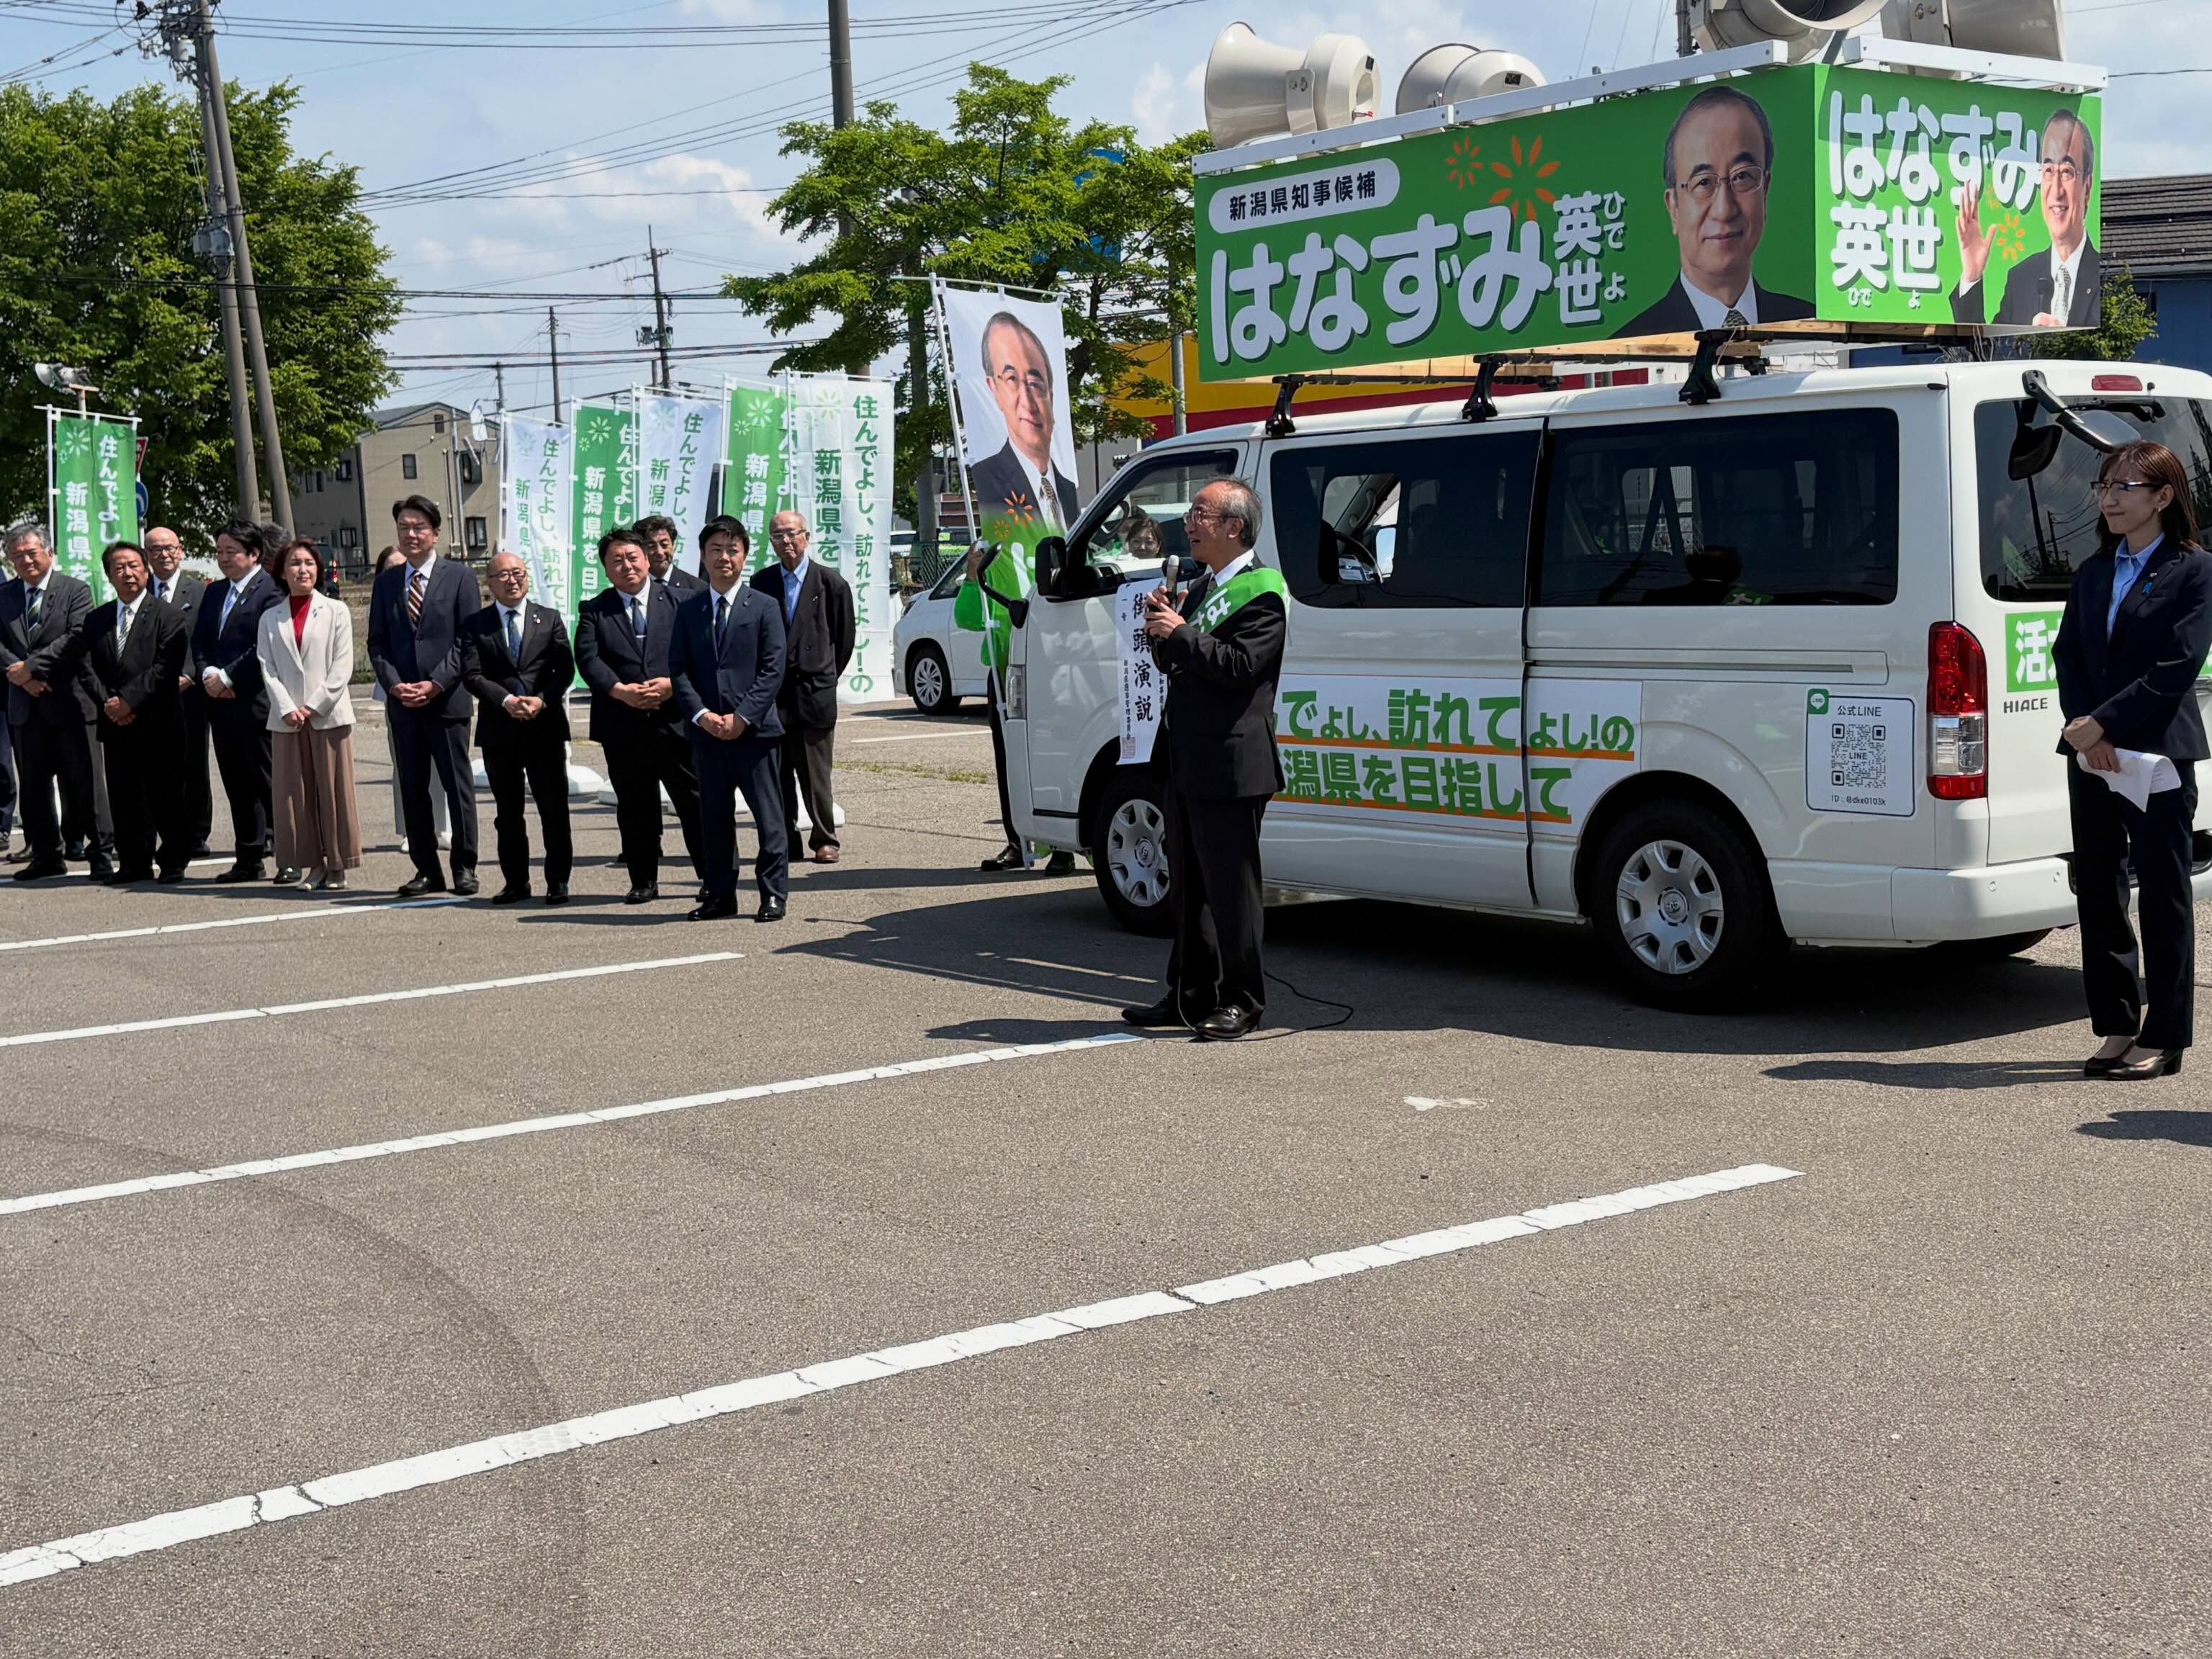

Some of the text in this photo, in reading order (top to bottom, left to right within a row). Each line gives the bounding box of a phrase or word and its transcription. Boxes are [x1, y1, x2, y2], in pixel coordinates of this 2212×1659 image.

[1829, 91, 2043, 210] はなずみ
[1229, 171, 1377, 222] 新潟県知事候補
[1553, 190, 1603, 325] 英世
[1830, 200, 1942, 289] 英世
[1210, 205, 1554, 364] はなずみ
[649, 457, 670, 516] 新潟
[814, 447, 842, 575] 新潟県を
[1273, 688, 1635, 754] でよし、訪れてよし!の
[1837, 705, 1882, 717] 公式LINE
[2003, 697, 2049, 714] HIACE
[1277, 748, 1573, 817] 潟県を目指して
